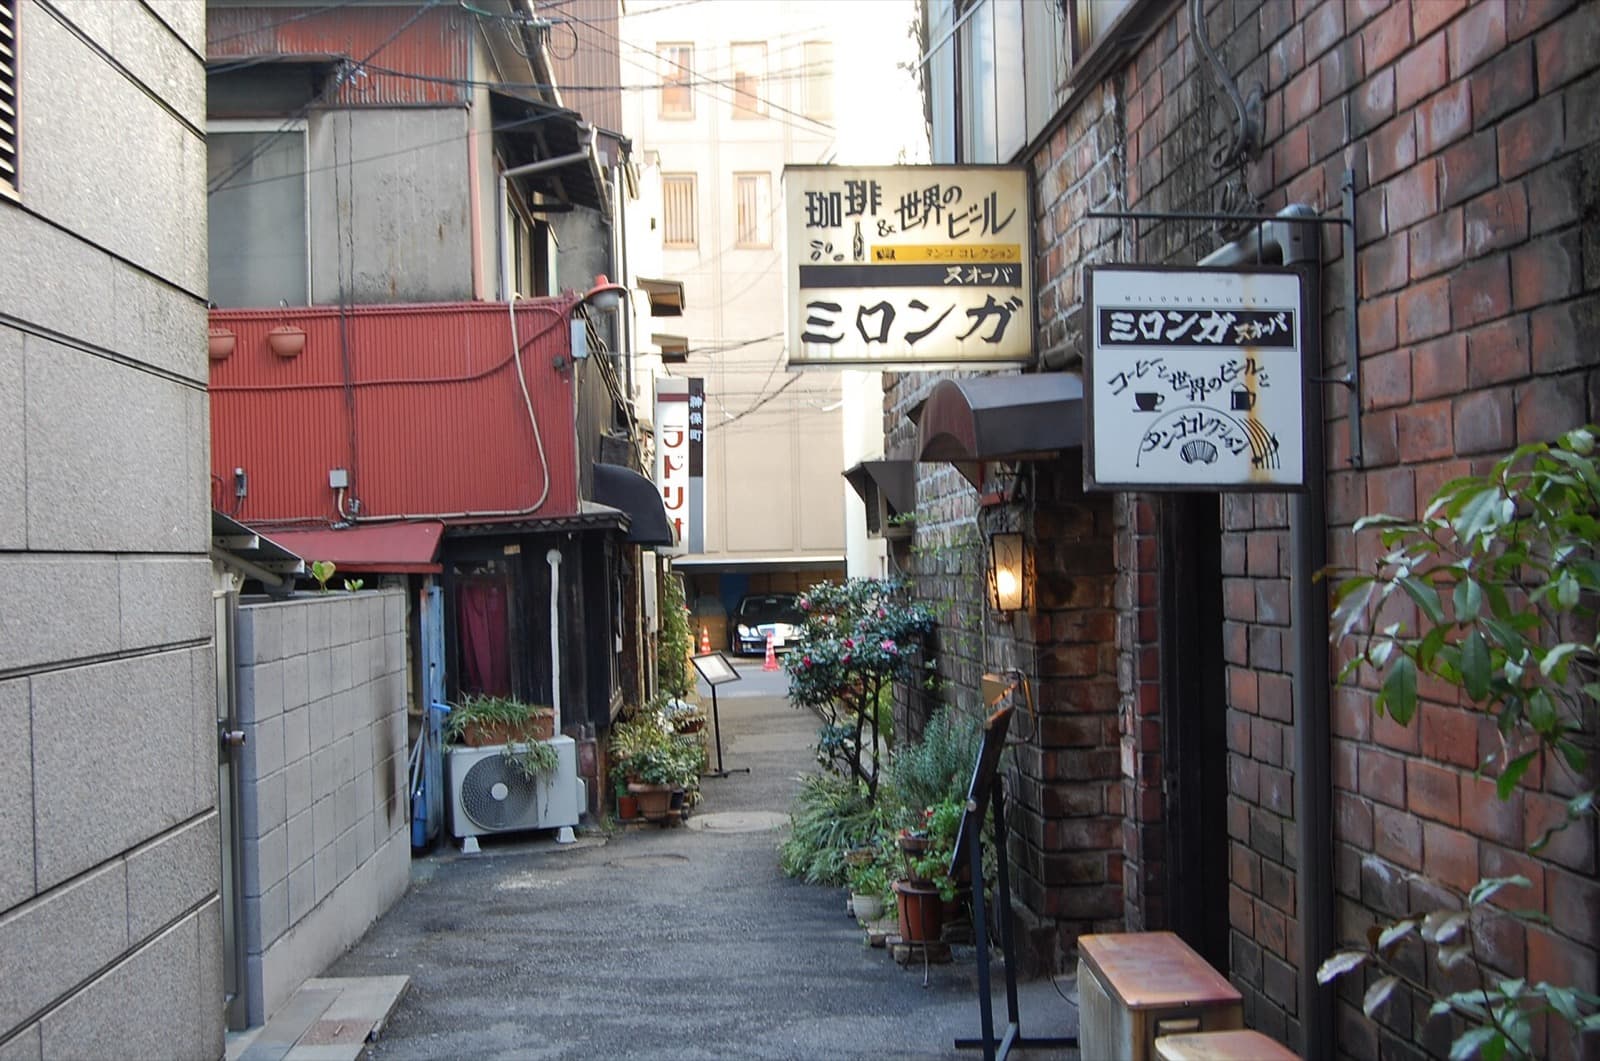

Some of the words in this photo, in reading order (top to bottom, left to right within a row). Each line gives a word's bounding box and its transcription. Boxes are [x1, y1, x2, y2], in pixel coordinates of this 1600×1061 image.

[802, 295, 1023, 344] ミロンガ
[1109, 311, 1235, 344] ミロンガ
[1142, 412, 1249, 456] タンゴコレクション
